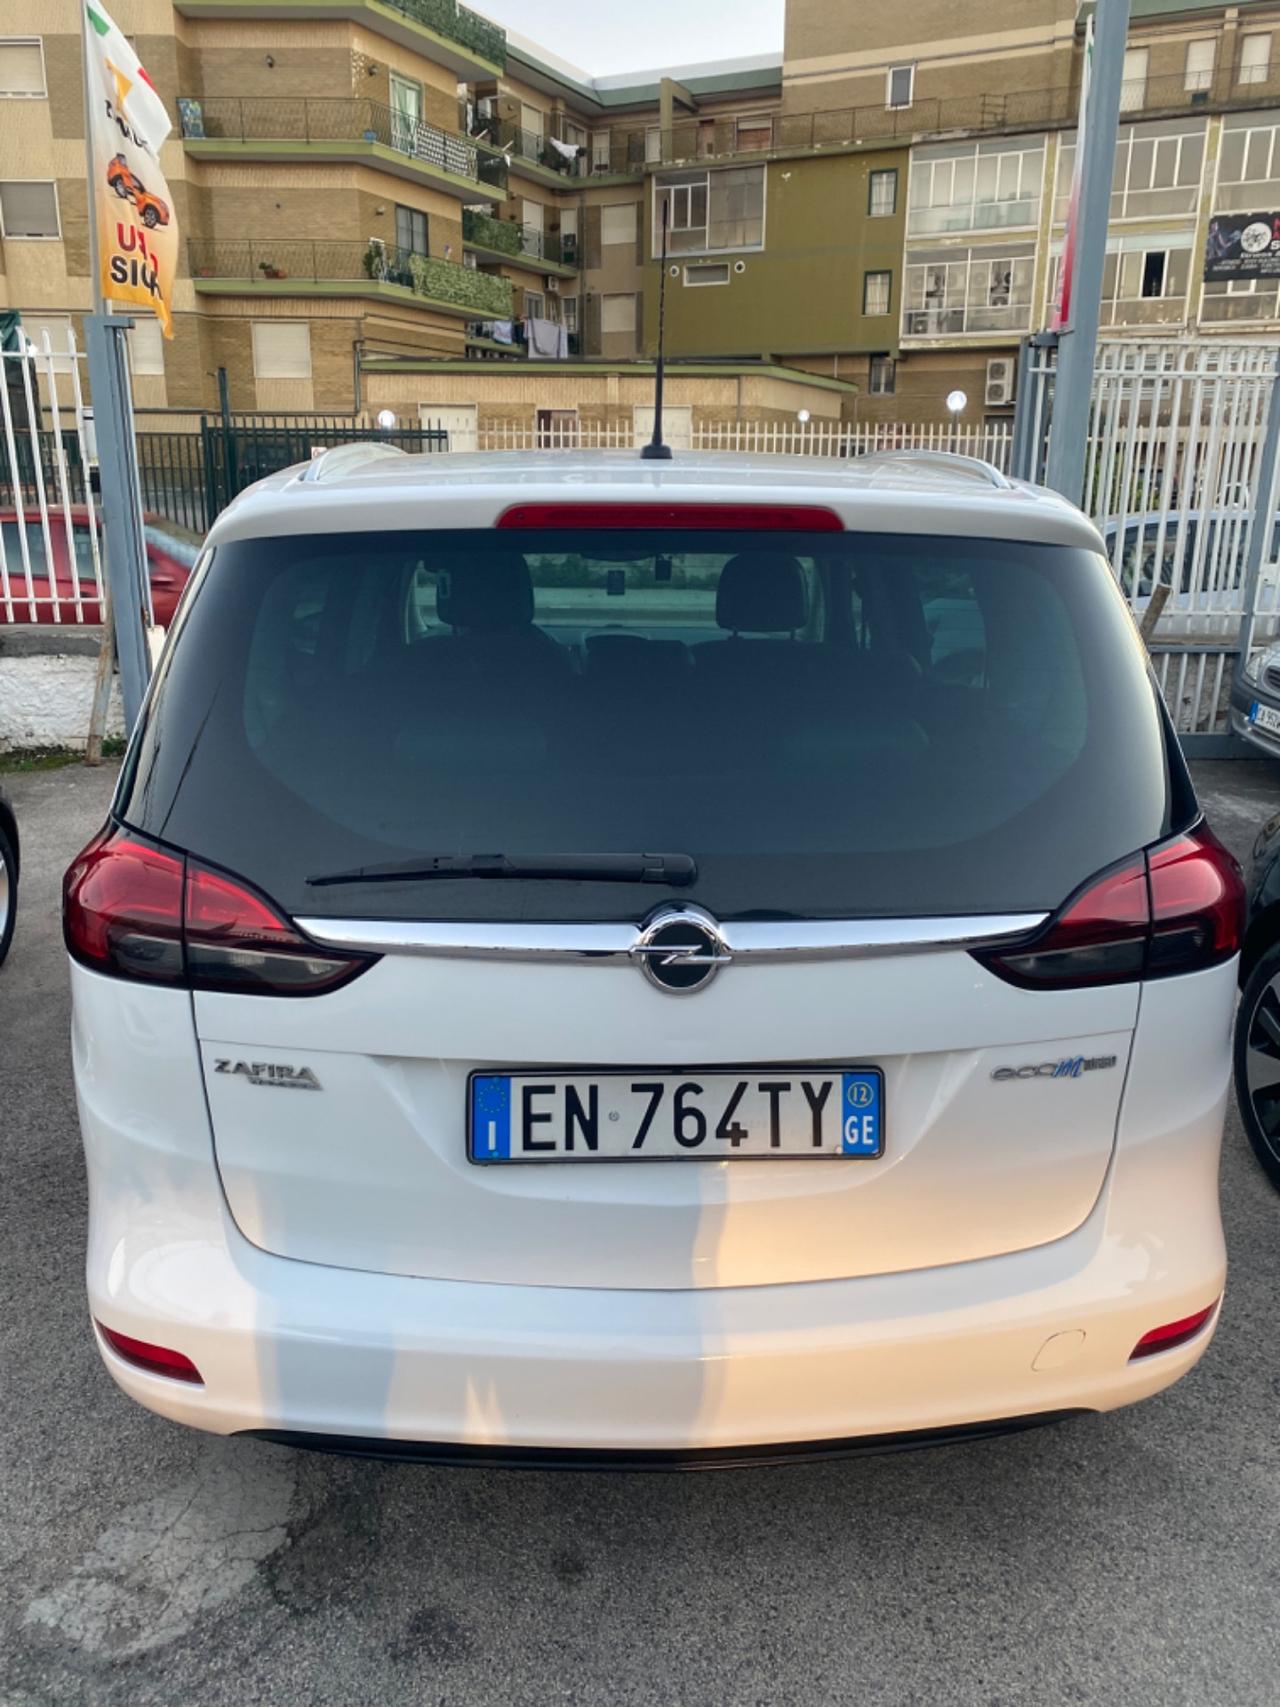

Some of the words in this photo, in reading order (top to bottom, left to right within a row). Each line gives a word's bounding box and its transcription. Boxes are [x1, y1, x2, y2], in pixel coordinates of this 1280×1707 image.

[214, 1059, 318, 1080] ZAFIRA
[852, 1086, 868, 1102] 12
[522, 1084, 598, 1151] EN
[631, 1082, 833, 1150] 764TY
[844, 1115, 874, 1145] GE
